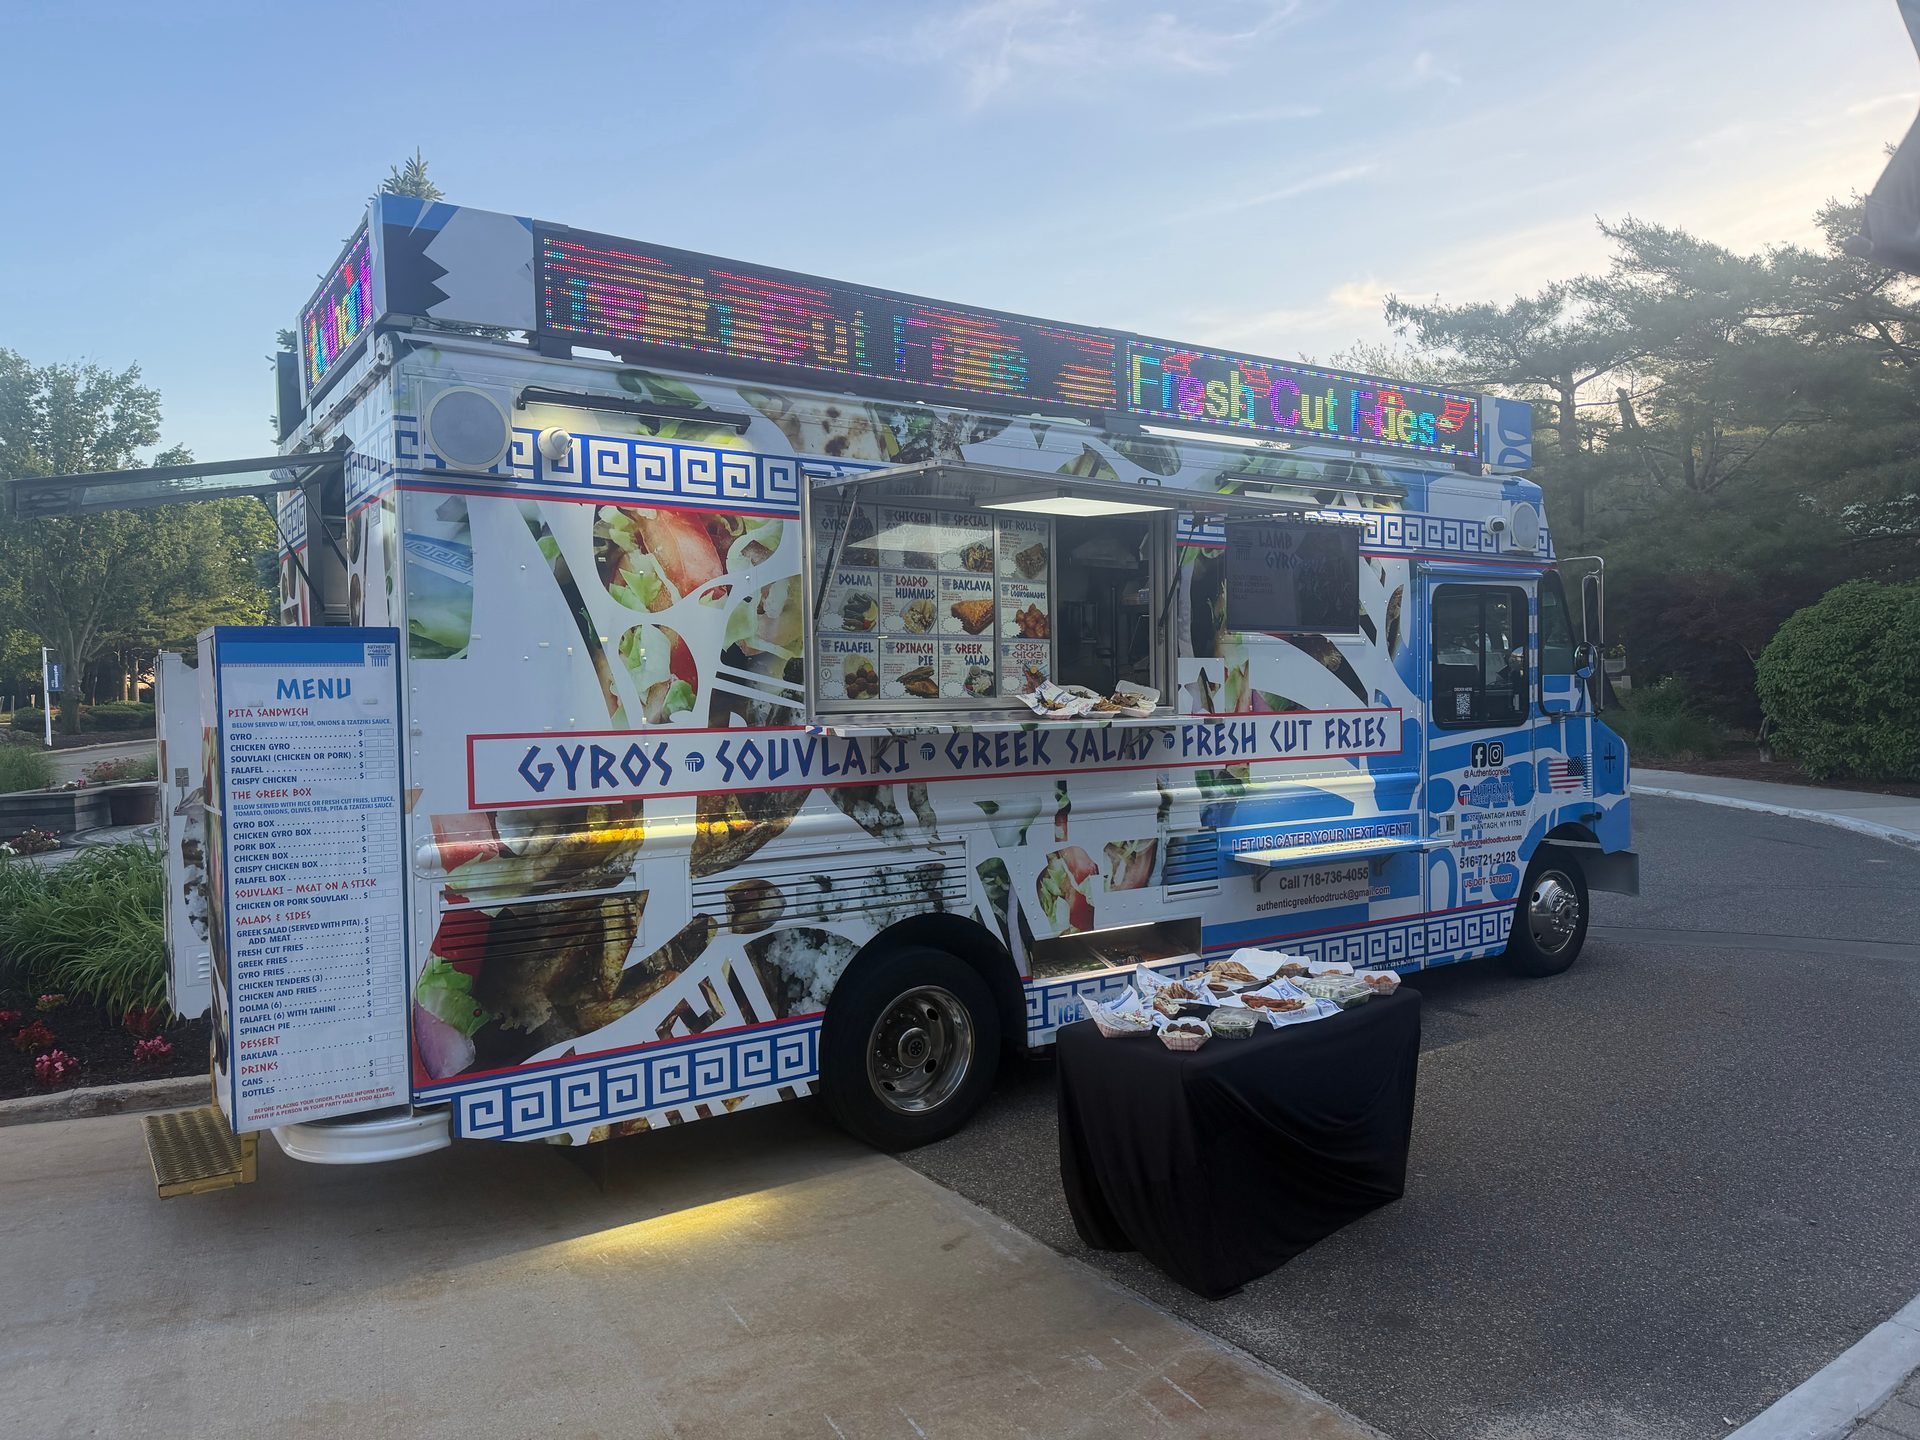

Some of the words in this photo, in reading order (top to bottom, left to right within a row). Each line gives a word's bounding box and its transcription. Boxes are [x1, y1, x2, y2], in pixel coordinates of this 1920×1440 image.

[1132, 354, 1254, 419] Fresh
[1270, 378, 1338, 431] Cut
[894, 510, 931, 524] CHICKEN
[954, 514, 988, 527] SPECIAL
[1016, 520, 1037, 532] ROLLS
[839, 574, 872, 586] DOLMA
[896, 575, 928, 586] LOADED
[953, 579, 992, 592] BAKLAVA
[896, 588, 935, 599] HUMMUS
[834, 642, 874, 653] FALAFEL
[896, 643, 933, 654] SPINACH
[955, 644, 982, 654] GREEK
[919, 656, 933, 665] PIE
[965, 655, 990, 665] SALAD
[276, 678, 351, 700] MENU
[228, 709, 253, 717] PITA
[257, 708, 308, 717] SANDWICH
[231, 755, 270, 763] SOUVLAKI
[274, 753, 310, 762] (CHICKEN
[328, 752, 351, 760] PORK)
[518, 742, 673, 793] GYROS
[716, 735, 910, 783] SOUVLAKI
[944, 729, 1052, 770] GREEK
[1066, 727, 1154, 764] SALAD
[1182, 721, 1257, 757] FRESH
[1270, 719, 1313, 752] CUT
[1324, 715, 1388, 750] FRIES
[1464, 768, 1510, 778] @Authenticgreek
[232, 791, 251, 800] THE
[256, 789, 288, 798] GREEK
[293, 788, 312, 797] BOX
[1480, 811, 1506, 820] WANTAGH
[1506, 810, 1526, 818] AVENUE
[234, 832, 268, 840] CHICKEN
[1232, 838, 1254, 852] LET
[1258, 836, 1272, 849] US
[1276, 833, 1312, 848] CATER
[1313, 830, 1344, 842] YOUR
[1346, 826, 1374, 839] NEXT
[234, 853, 269, 862] CHICKEN
[1460, 851, 1516, 868] 516-721-2128
[235, 865, 262, 874] CRISPY
[265, 862, 299, 871] CHICKEN
[235, 876, 267, 884] FALAFEL
[1280, 875, 1300, 890] Call
[1303, 867, 1368, 888] 718-736-4055
[235, 886, 283, 899] SOUVLAKI
[296, 883, 322, 893] MEAT
[325, 882, 338, 891] ON
[342, 881, 348, 889] A
[350, 879, 376, 889] STICK
[236, 901, 271, 911] CHICKEN
[287, 898, 308, 906] PORK
[311, 894, 348, 904] SOUVLAKI
[236, 914, 271, 926] SALADS
[285, 911, 311, 921] SIDES
[237, 928, 261, 938] GREEK
[263, 926, 287, 935] SALAD
[289, 923, 319, 934] (SERVED
[321, 922, 340, 930] WITH
[342, 920, 360, 929] PITA)
[249, 937, 266, 945] ADD
[270, 934, 291, 943] MEAT
[238, 948, 262, 957] FRESH
[265, 946, 280, 954] CUT
[283, 944, 303, 953] FRIES
[238, 959, 263, 969] GREEK
[266, 957, 287, 966] FRIES
[238, 971, 260, 980] GYRO
[263, 968, 284, 977] FRIES
[238, 980, 273, 991] CHICKEN
[276, 976, 310, 987] TENDERS
[312, 974, 322, 984] (3)
[239, 991, 274, 1002] CHICKEN
[276, 989, 294, 997] AND
[297, 986, 317, 995] FRIES
[240, 1003, 268, 1013] DOLMA
[271, 1001, 282, 1010] (6)
[240, 1013, 271, 1024] FALAFEL
[274, 1011, 284, 1021] (6)
[287, 1009, 307, 1018] WITH
[310, 1005, 336, 1015] TAHINI
[240, 1024, 275, 1035] SPINACH
[278, 1022, 290, 1030] PIE
[241, 1036, 280, 1049] DESSERT
[241, 1050, 278, 1062] BAKLAVA
[242, 1062, 278, 1075] DRINKS
[242, 1077, 263, 1087] CANS
[242, 1087, 275, 1098] BOTTLES
